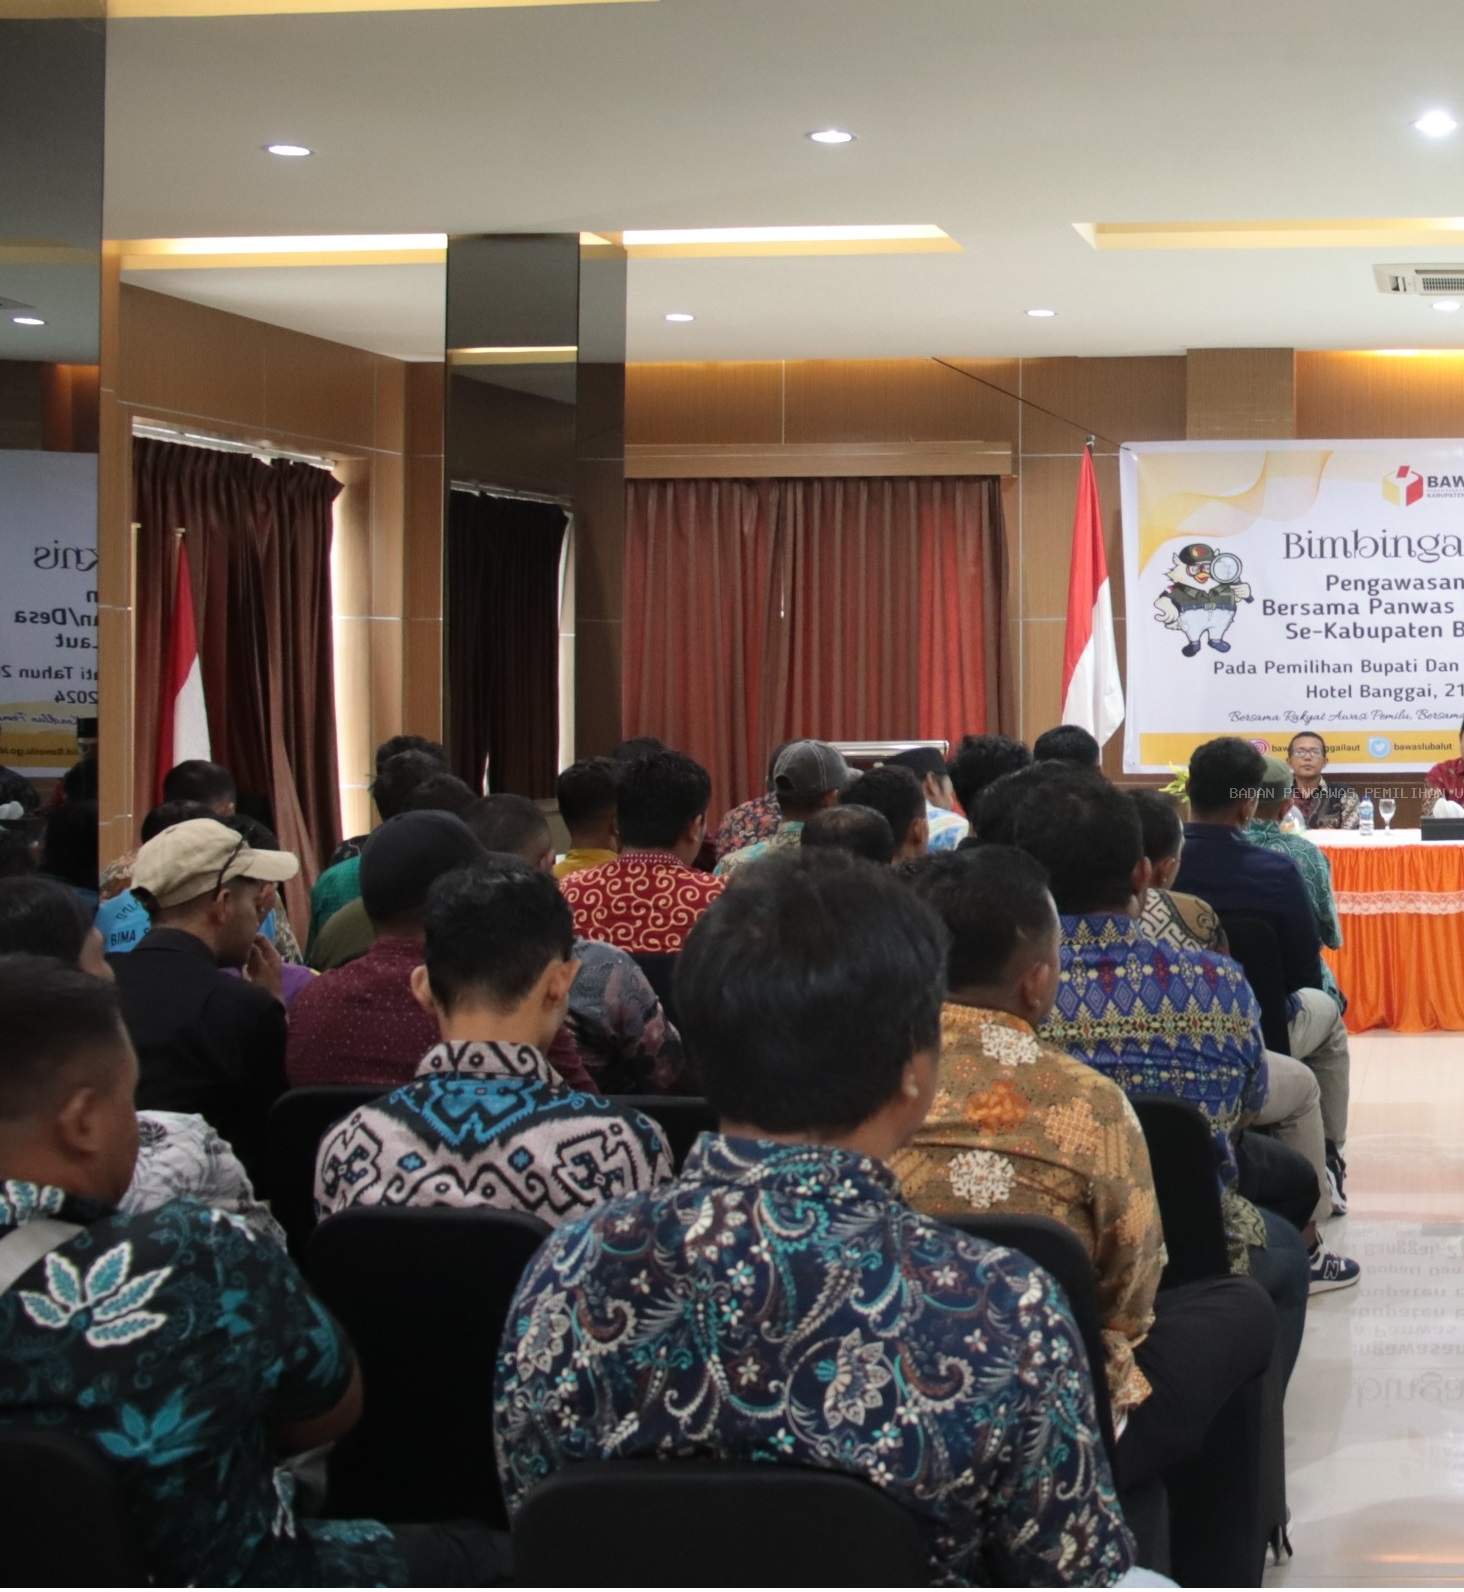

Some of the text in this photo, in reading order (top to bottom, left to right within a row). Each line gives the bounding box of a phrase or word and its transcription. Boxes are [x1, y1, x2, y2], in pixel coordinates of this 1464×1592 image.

[1262, 598, 1360, 616] Bersama
[1369, 597, 1455, 615] Panwas
[1286, 621, 1443, 643] Se-Kabupaten
[1213, 660, 1257, 674] Pada
[1264, 659, 1353, 674] Pemilihan
[1361, 658, 1418, 676] Bupati
[1426, 658, 1459, 672] Dan
[1306, 684, 1353, 699] Hotel
[1360, 683, 1438, 702] Banggai,
[1228, 710, 1280, 722] Bersama
[1284, 709, 1325, 726] Rakyat
